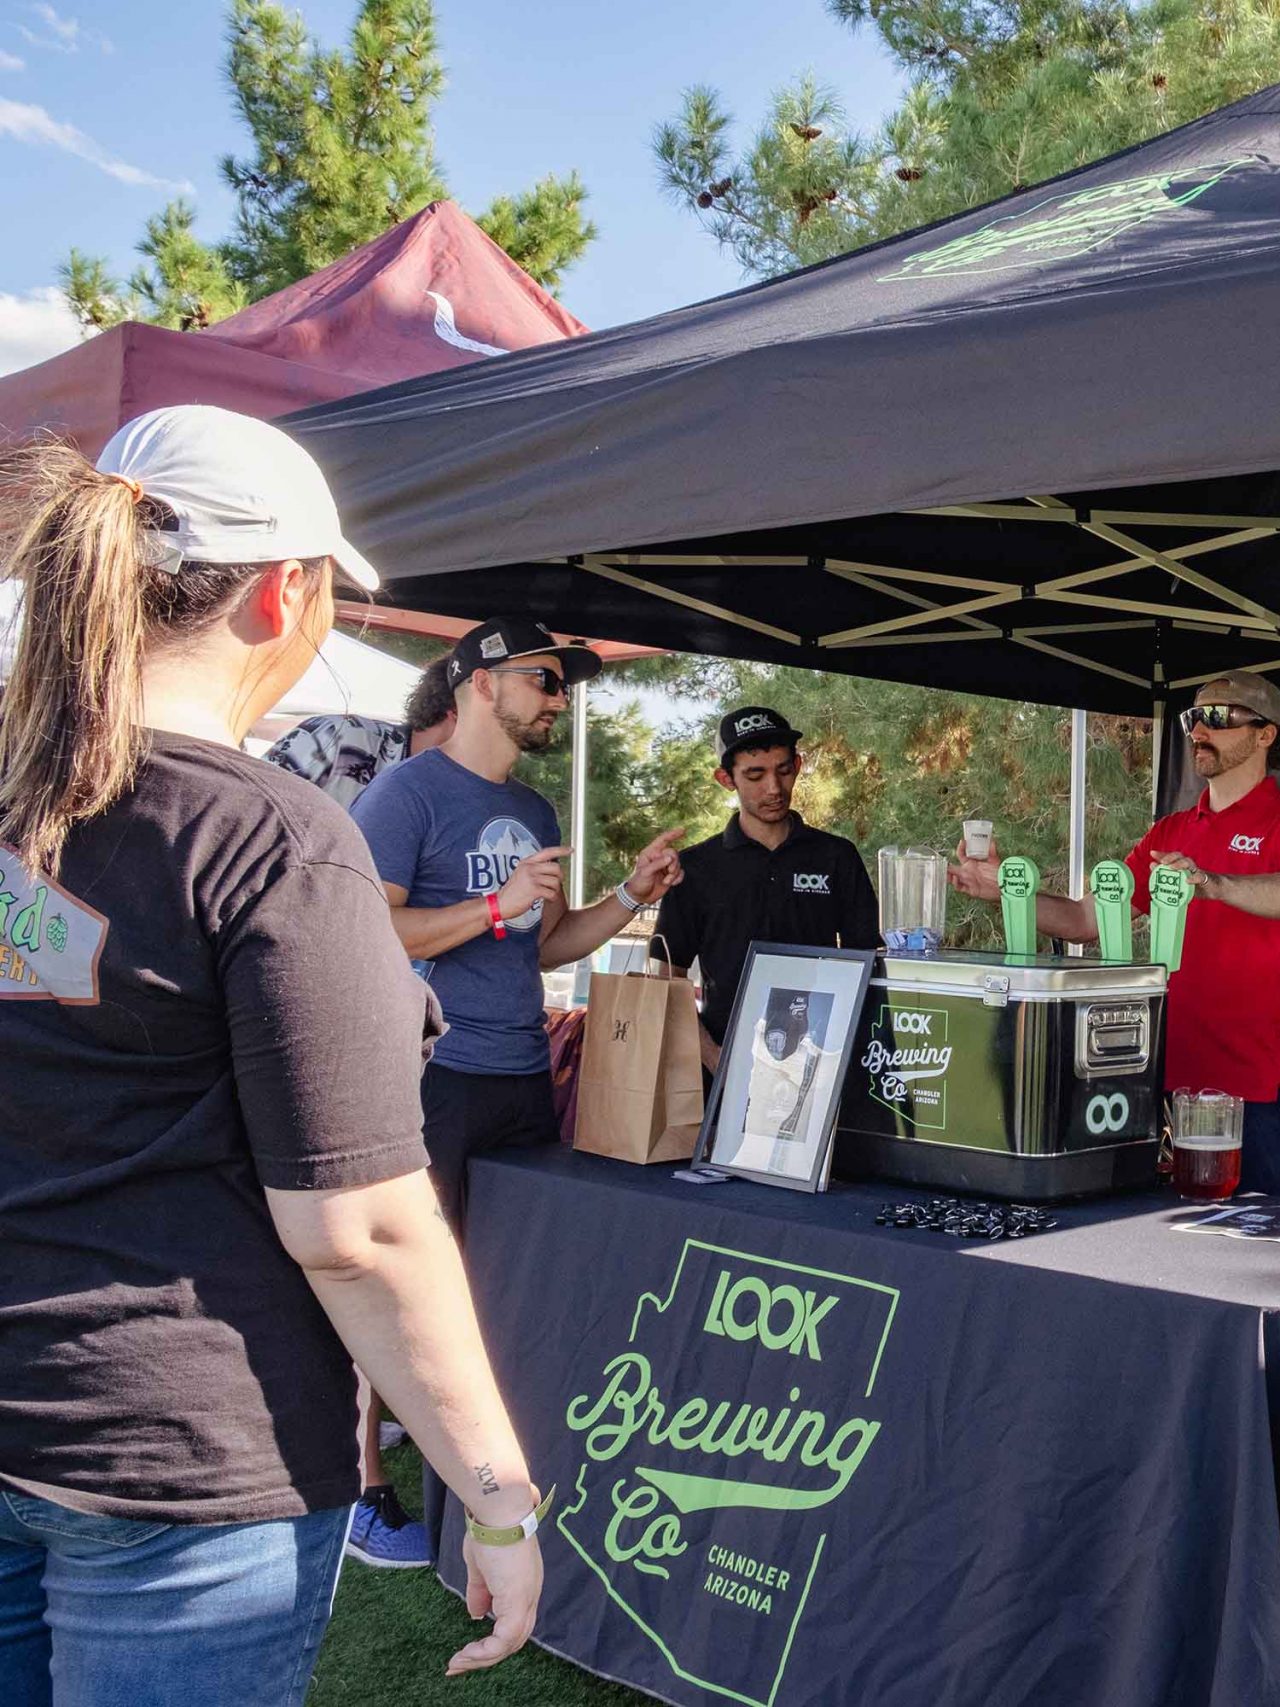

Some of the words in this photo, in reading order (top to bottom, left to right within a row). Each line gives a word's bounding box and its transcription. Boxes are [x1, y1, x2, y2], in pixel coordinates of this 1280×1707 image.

[734, 714, 774, 733] LOOK
[1230, 833, 1265, 851] LOOK
[793, 873, 830, 890] LOOK
[1097, 872, 1119, 883] LOOK
[1158, 873, 1180, 886] LOOK
[893, 1011, 932, 1035] LOOK
[861, 1040, 953, 1075] Brewing
[881, 1076, 908, 1101] Co
[913, 1089, 940, 1098] CHANDLER
[703, 1270, 840, 1361] LOOK
[566, 1352, 881, 1490] Brewing
[604, 1479, 688, 1572] Co
[708, 1544, 790, 1591] CHANDLER
[703, 1572, 772, 1615] ARIZONA
